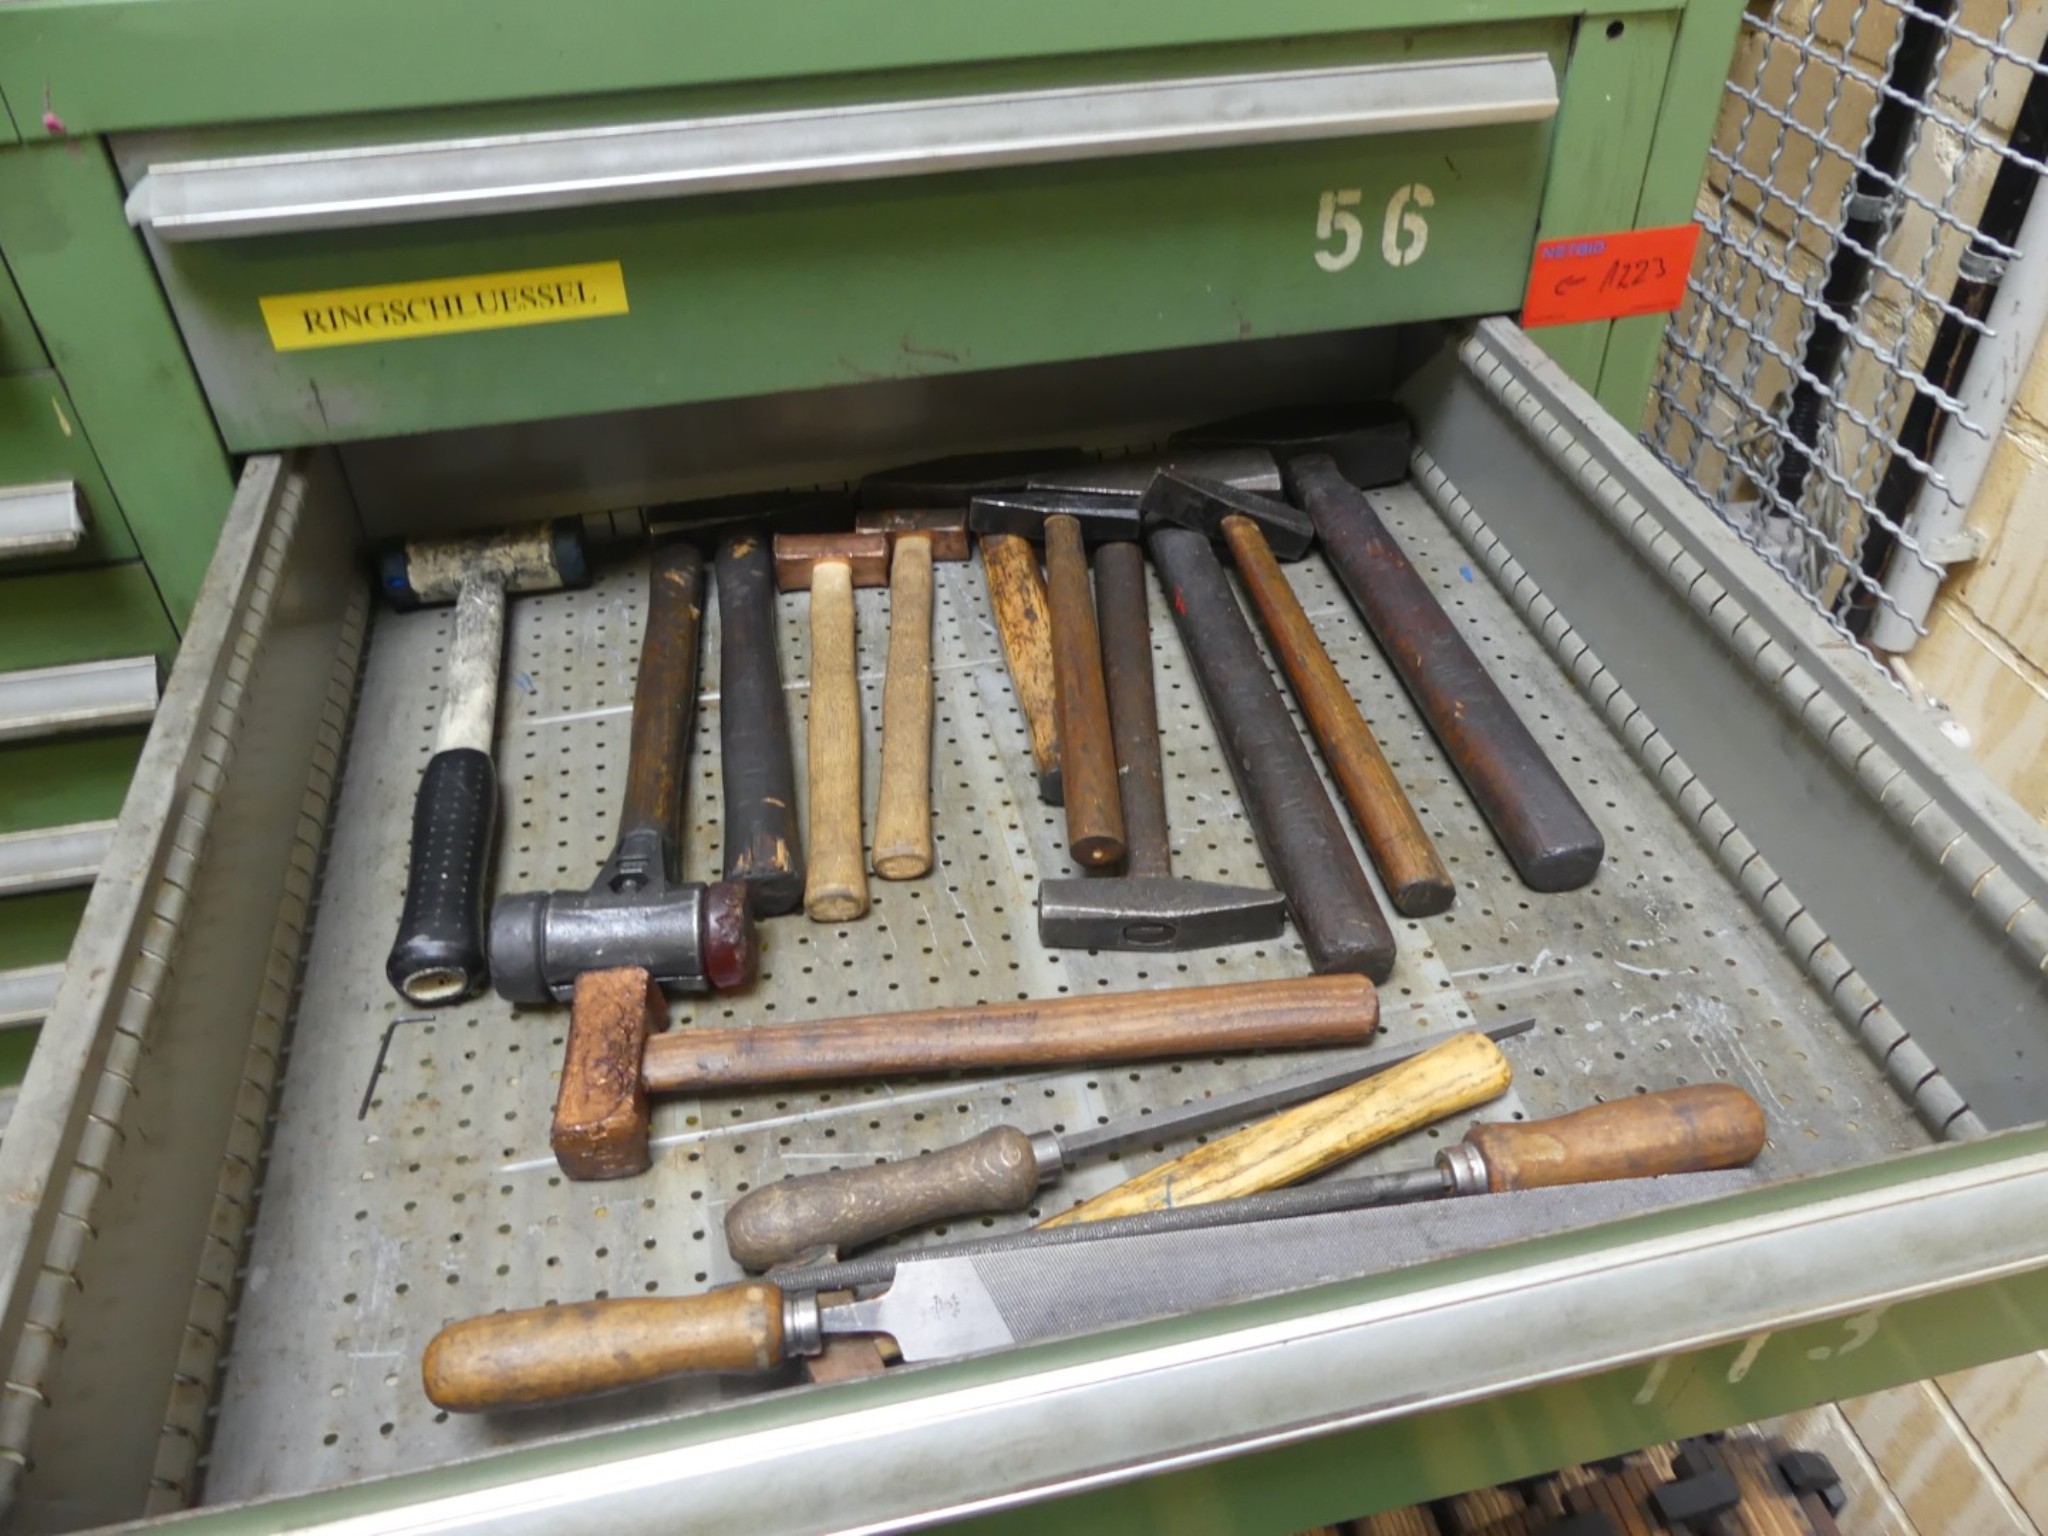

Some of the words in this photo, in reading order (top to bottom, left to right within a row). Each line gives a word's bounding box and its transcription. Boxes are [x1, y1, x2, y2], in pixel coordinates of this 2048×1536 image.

[1314, 183, 1435, 272] 56
[1599, 256, 1667, 294] 1223
[302, 280, 597, 335] RINGSCHLUESSEL
